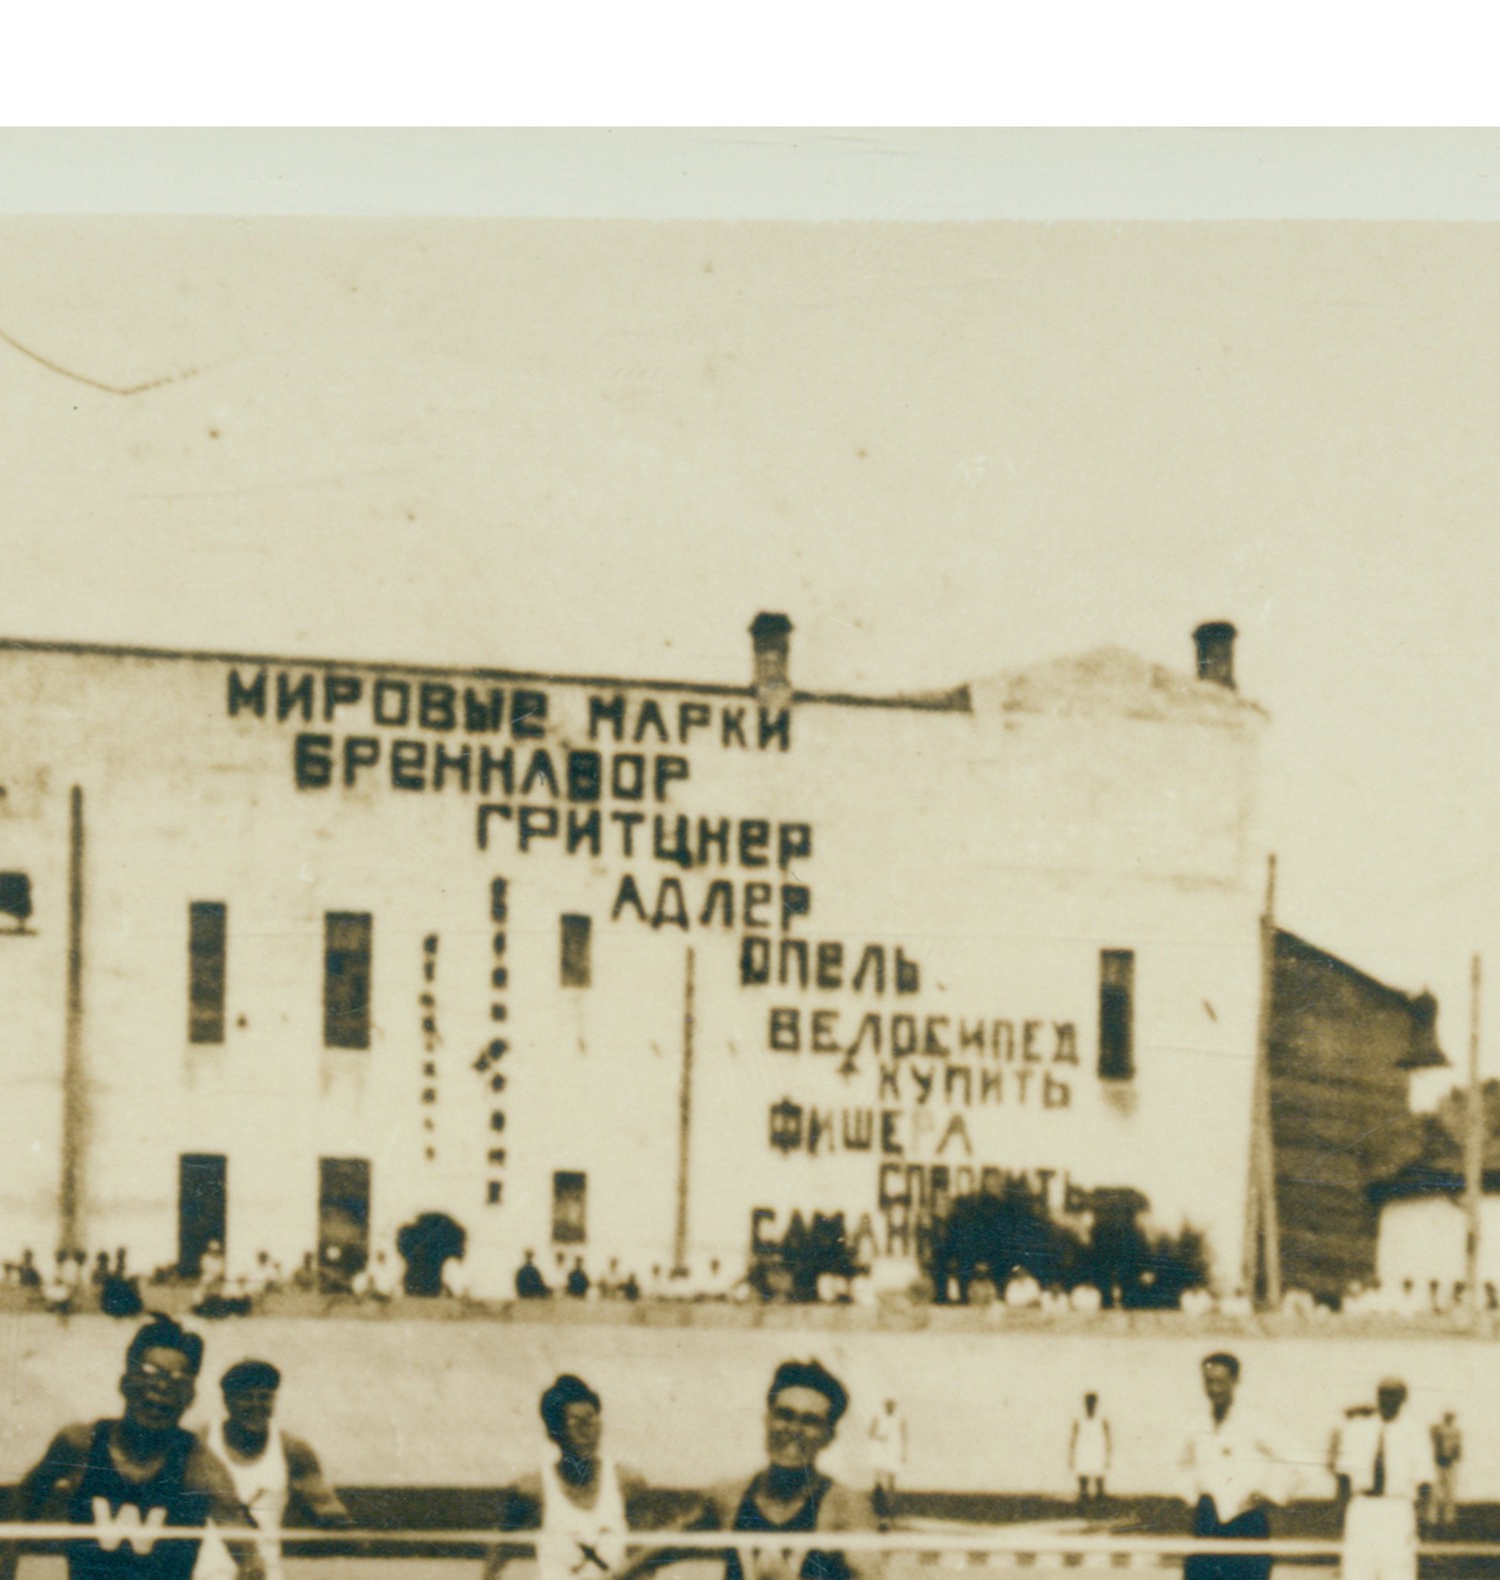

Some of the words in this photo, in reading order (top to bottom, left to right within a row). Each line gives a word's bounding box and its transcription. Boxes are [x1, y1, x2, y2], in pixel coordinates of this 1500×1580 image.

[227, 669, 550, 739] МИРОВЫЕ
[476, 803, 814, 869] ГРИТЦНЕР
[610, 874, 814, 932] АДЛЕР
[740, 935, 922, 994] ОПЕЛЬ
[768, 1007, 1082, 1066] ВЕЛОСИПЕД
[878, 1065, 1071, 1109] КУПИТЬ
[768, 1097, 974, 1157] ФИШЕРА
[92, 1496, 167, 1555] W
